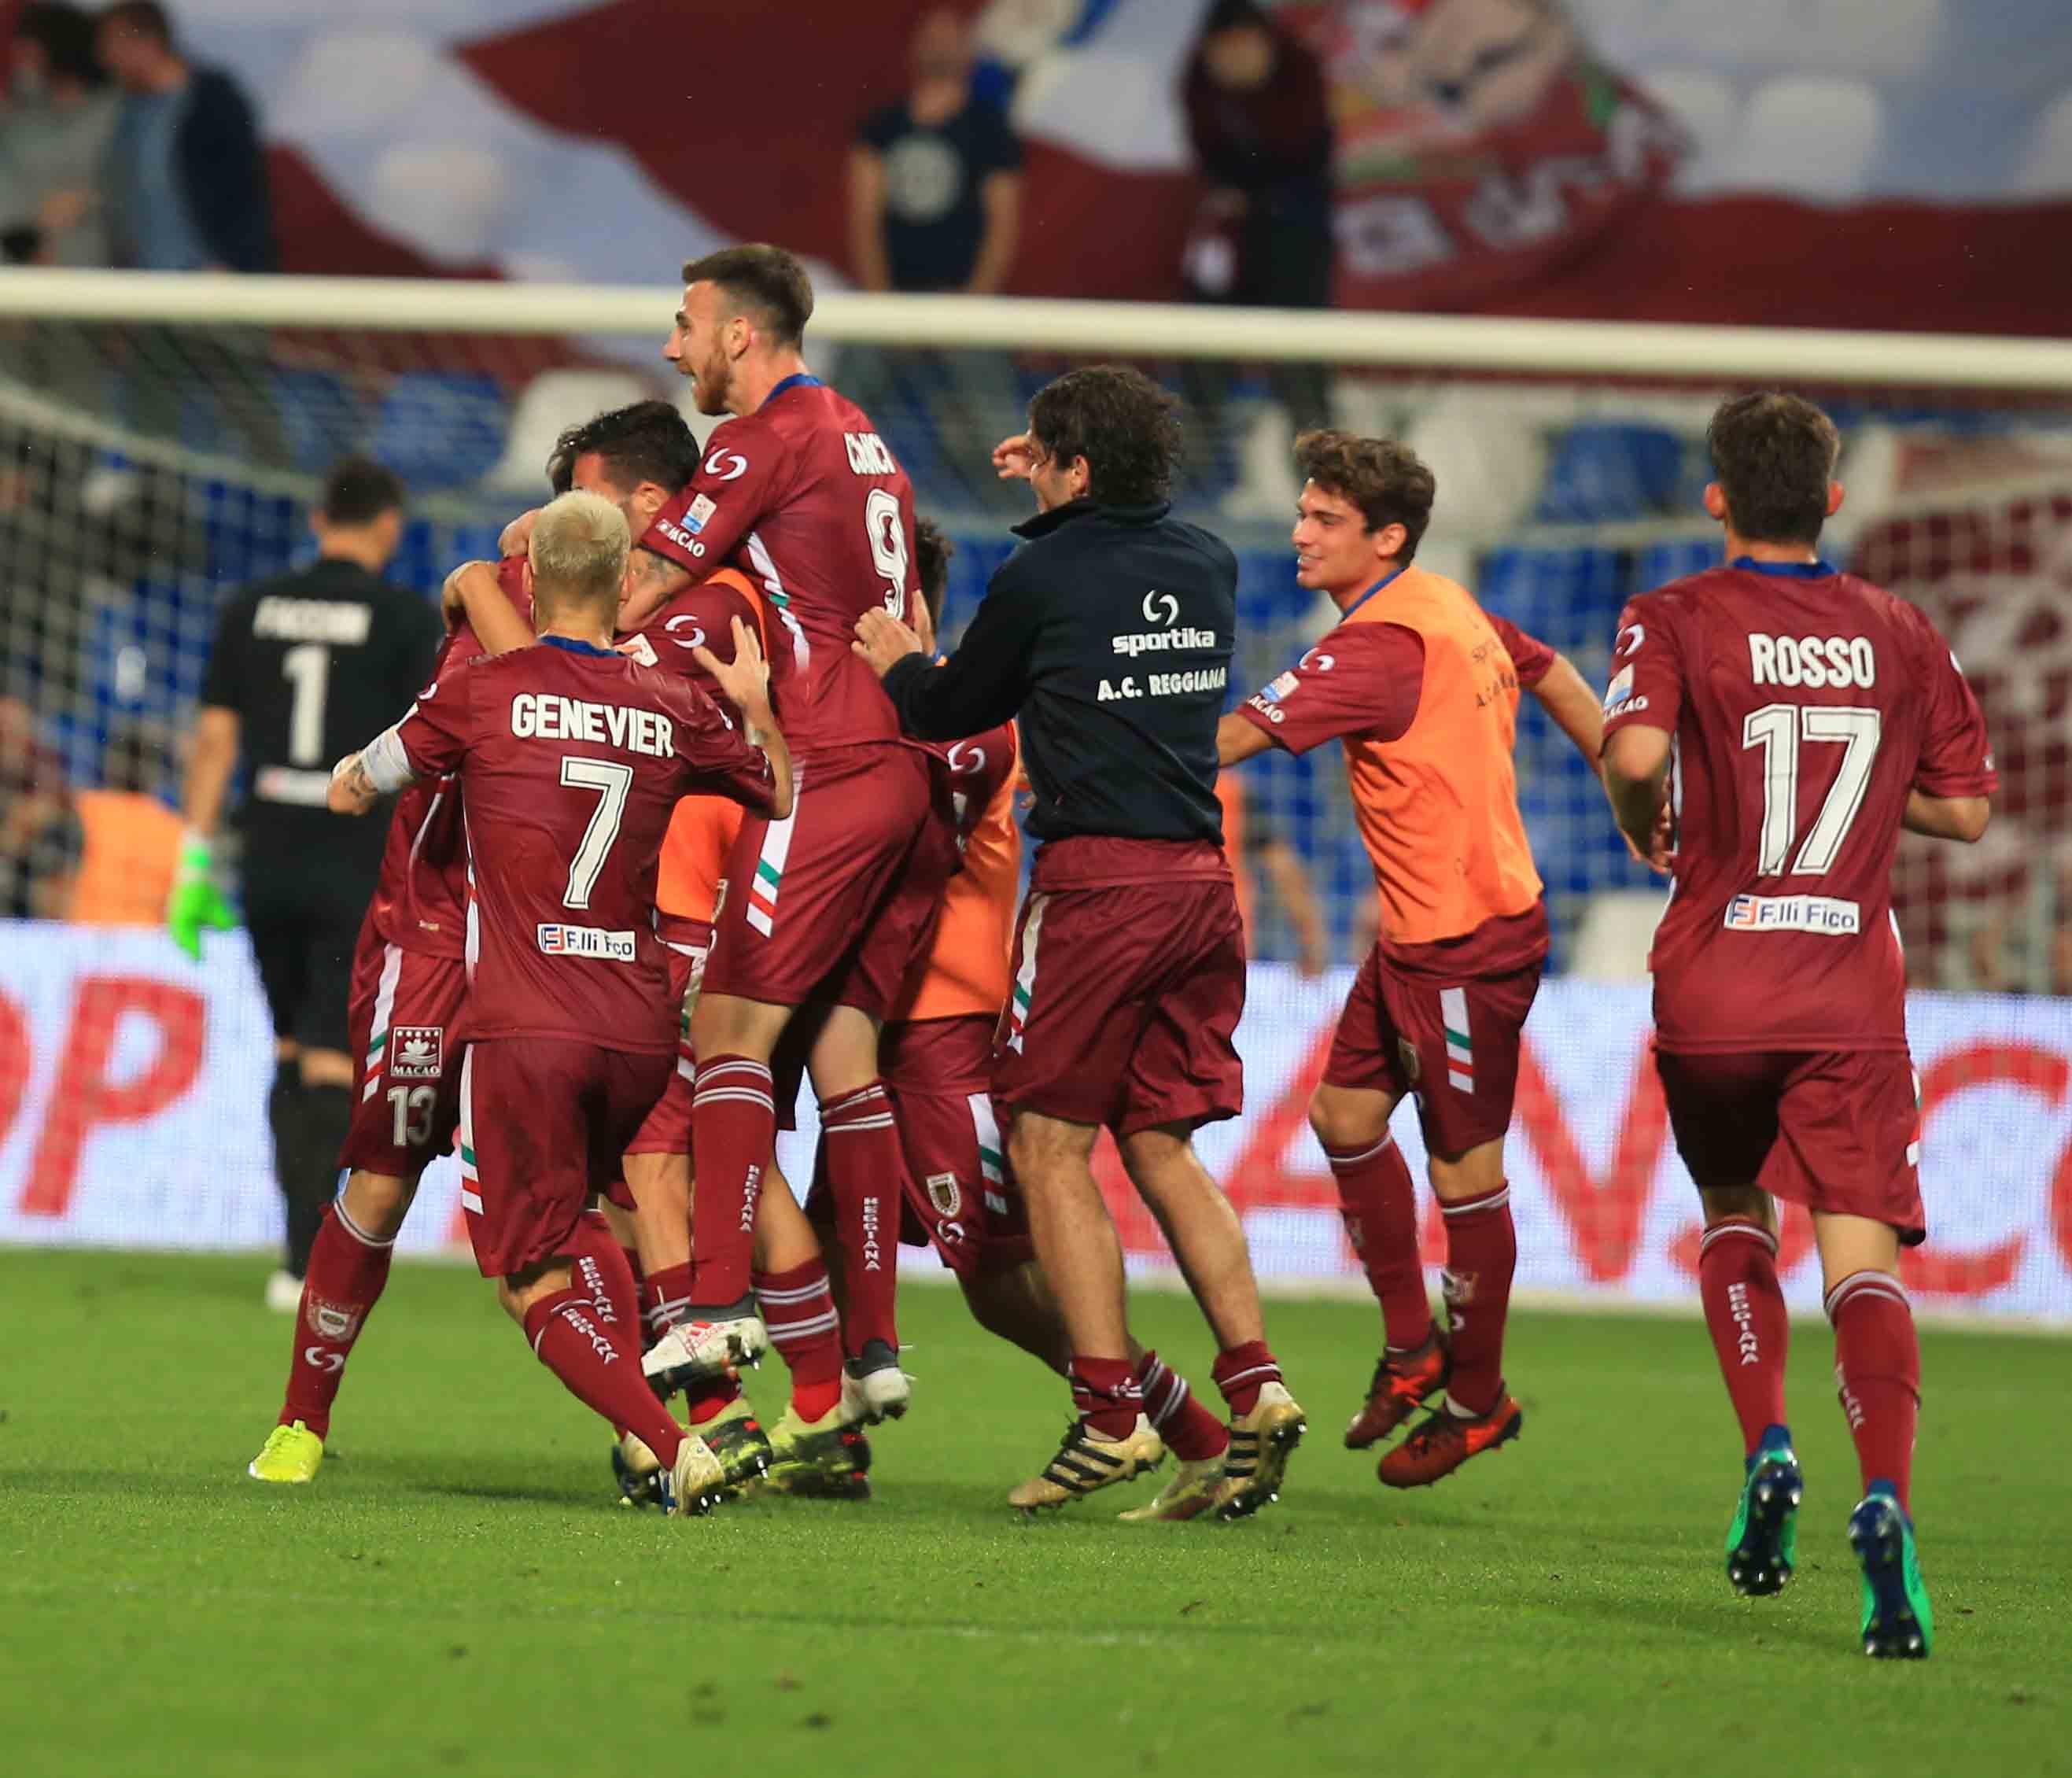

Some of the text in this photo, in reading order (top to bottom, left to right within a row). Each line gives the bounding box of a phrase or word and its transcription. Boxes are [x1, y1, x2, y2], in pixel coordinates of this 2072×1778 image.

[866, 488, 909, 618] 9
[1112, 627, 1215, 657] sportika
[1748, 633, 1876, 689] ROSSO
[281, 643, 330, 767] 1
[1097, 666, 1226, 702] A.C. REGGIANA
[1246, 694, 1285, 723] ACAO
[511, 692, 675, 758] GENEVIER
[1742, 703, 1882, 876] 17
[560, 754, 634, 910] 7
[1807, 904, 1856, 928] Fico
[393, 1065, 441, 1075] MACAO
[387, 1085, 437, 1146] 13
[863, 1197, 881, 1272] REGGIANA
[1727, 1282, 1760, 1366] REGGIANA
